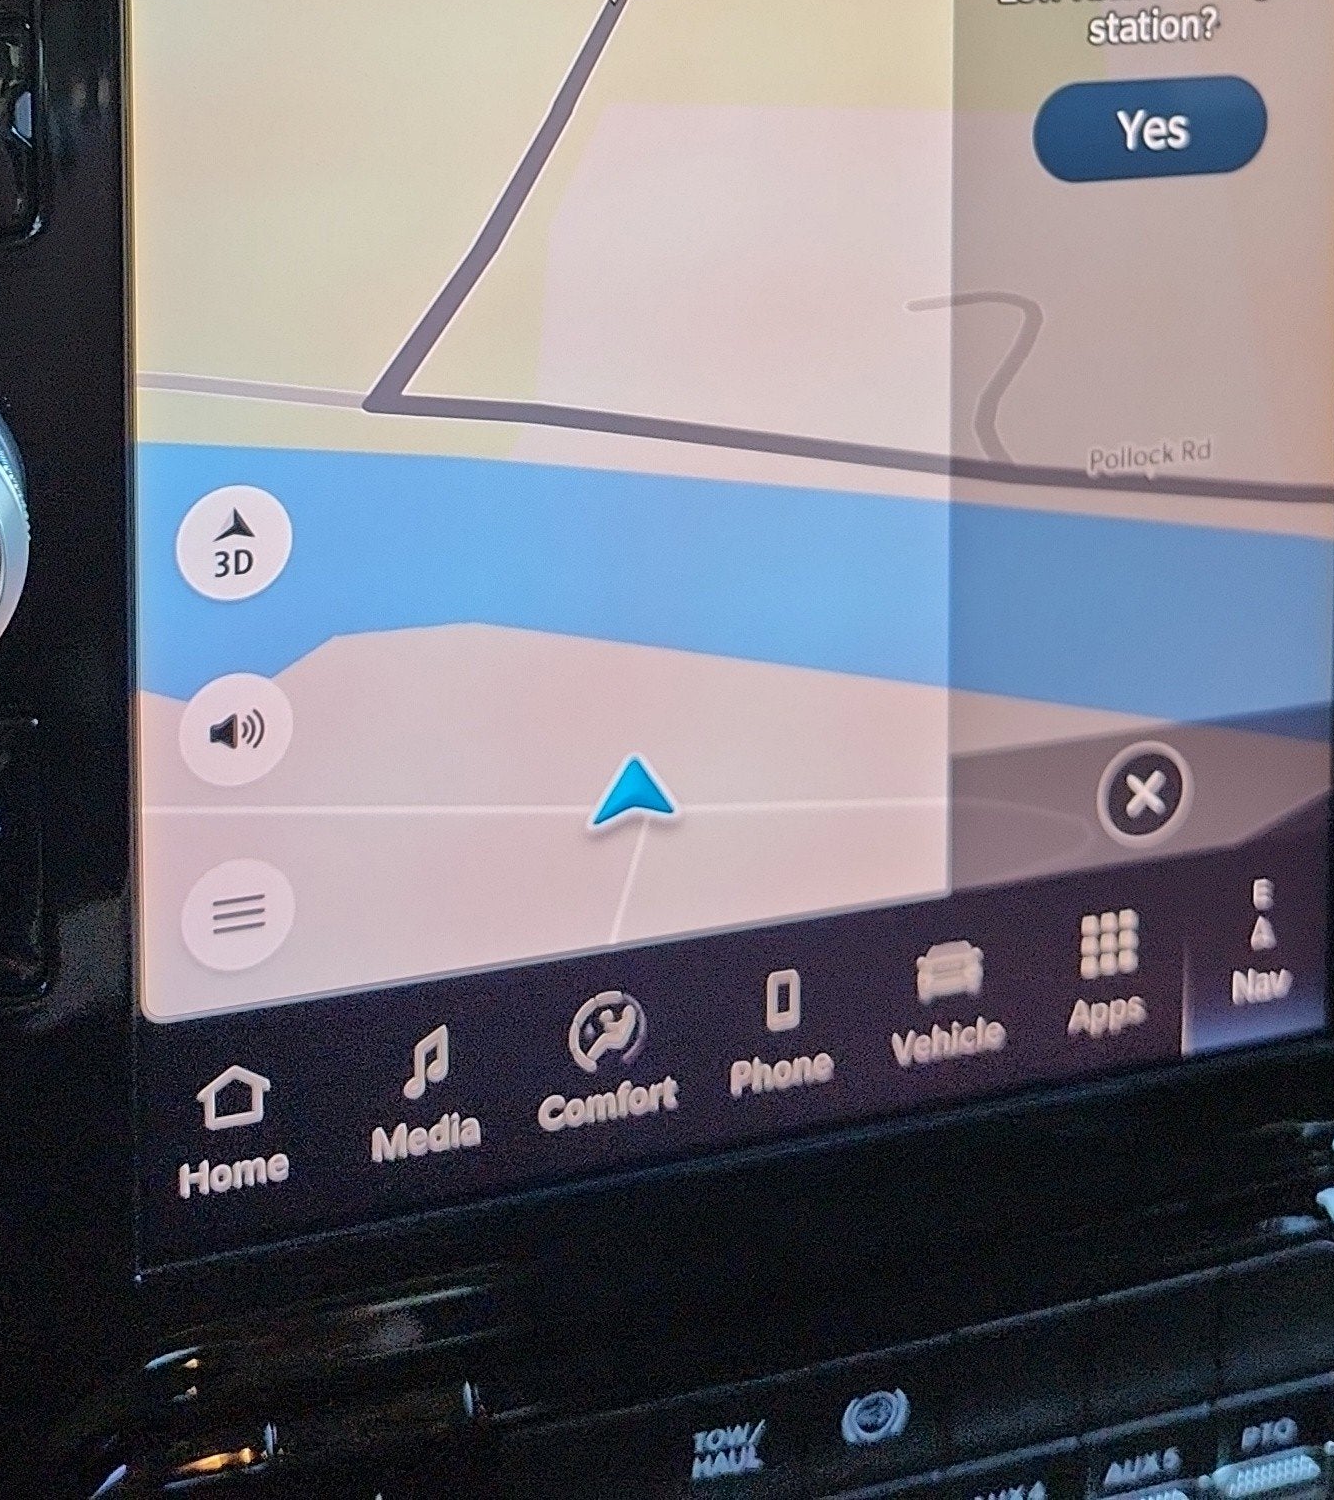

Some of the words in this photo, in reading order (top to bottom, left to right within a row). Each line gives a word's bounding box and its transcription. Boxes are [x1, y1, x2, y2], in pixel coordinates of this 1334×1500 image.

[1089, 6, 1218, 45] station?
[1117, 109, 1190, 151] Yes
[1090, 442, 1173, 470] Pollock
[1182, 440, 1211, 460] Rd
[214, 549, 254, 577] 3D
[1232, 967, 1293, 1005] Nav
[1068, 995, 1147, 1038] Apps
[891, 1017, 1007, 1067] Vehicle
[730, 1051, 835, 1097] Phone
[538, 1077, 679, 1131] Comfort
[371, 1112, 481, 1162] Media
[179, 1153, 289, 1197] Home
[693, 1418, 766, 1453] TOW/
[692, 1447, 762, 1479] HAUL
